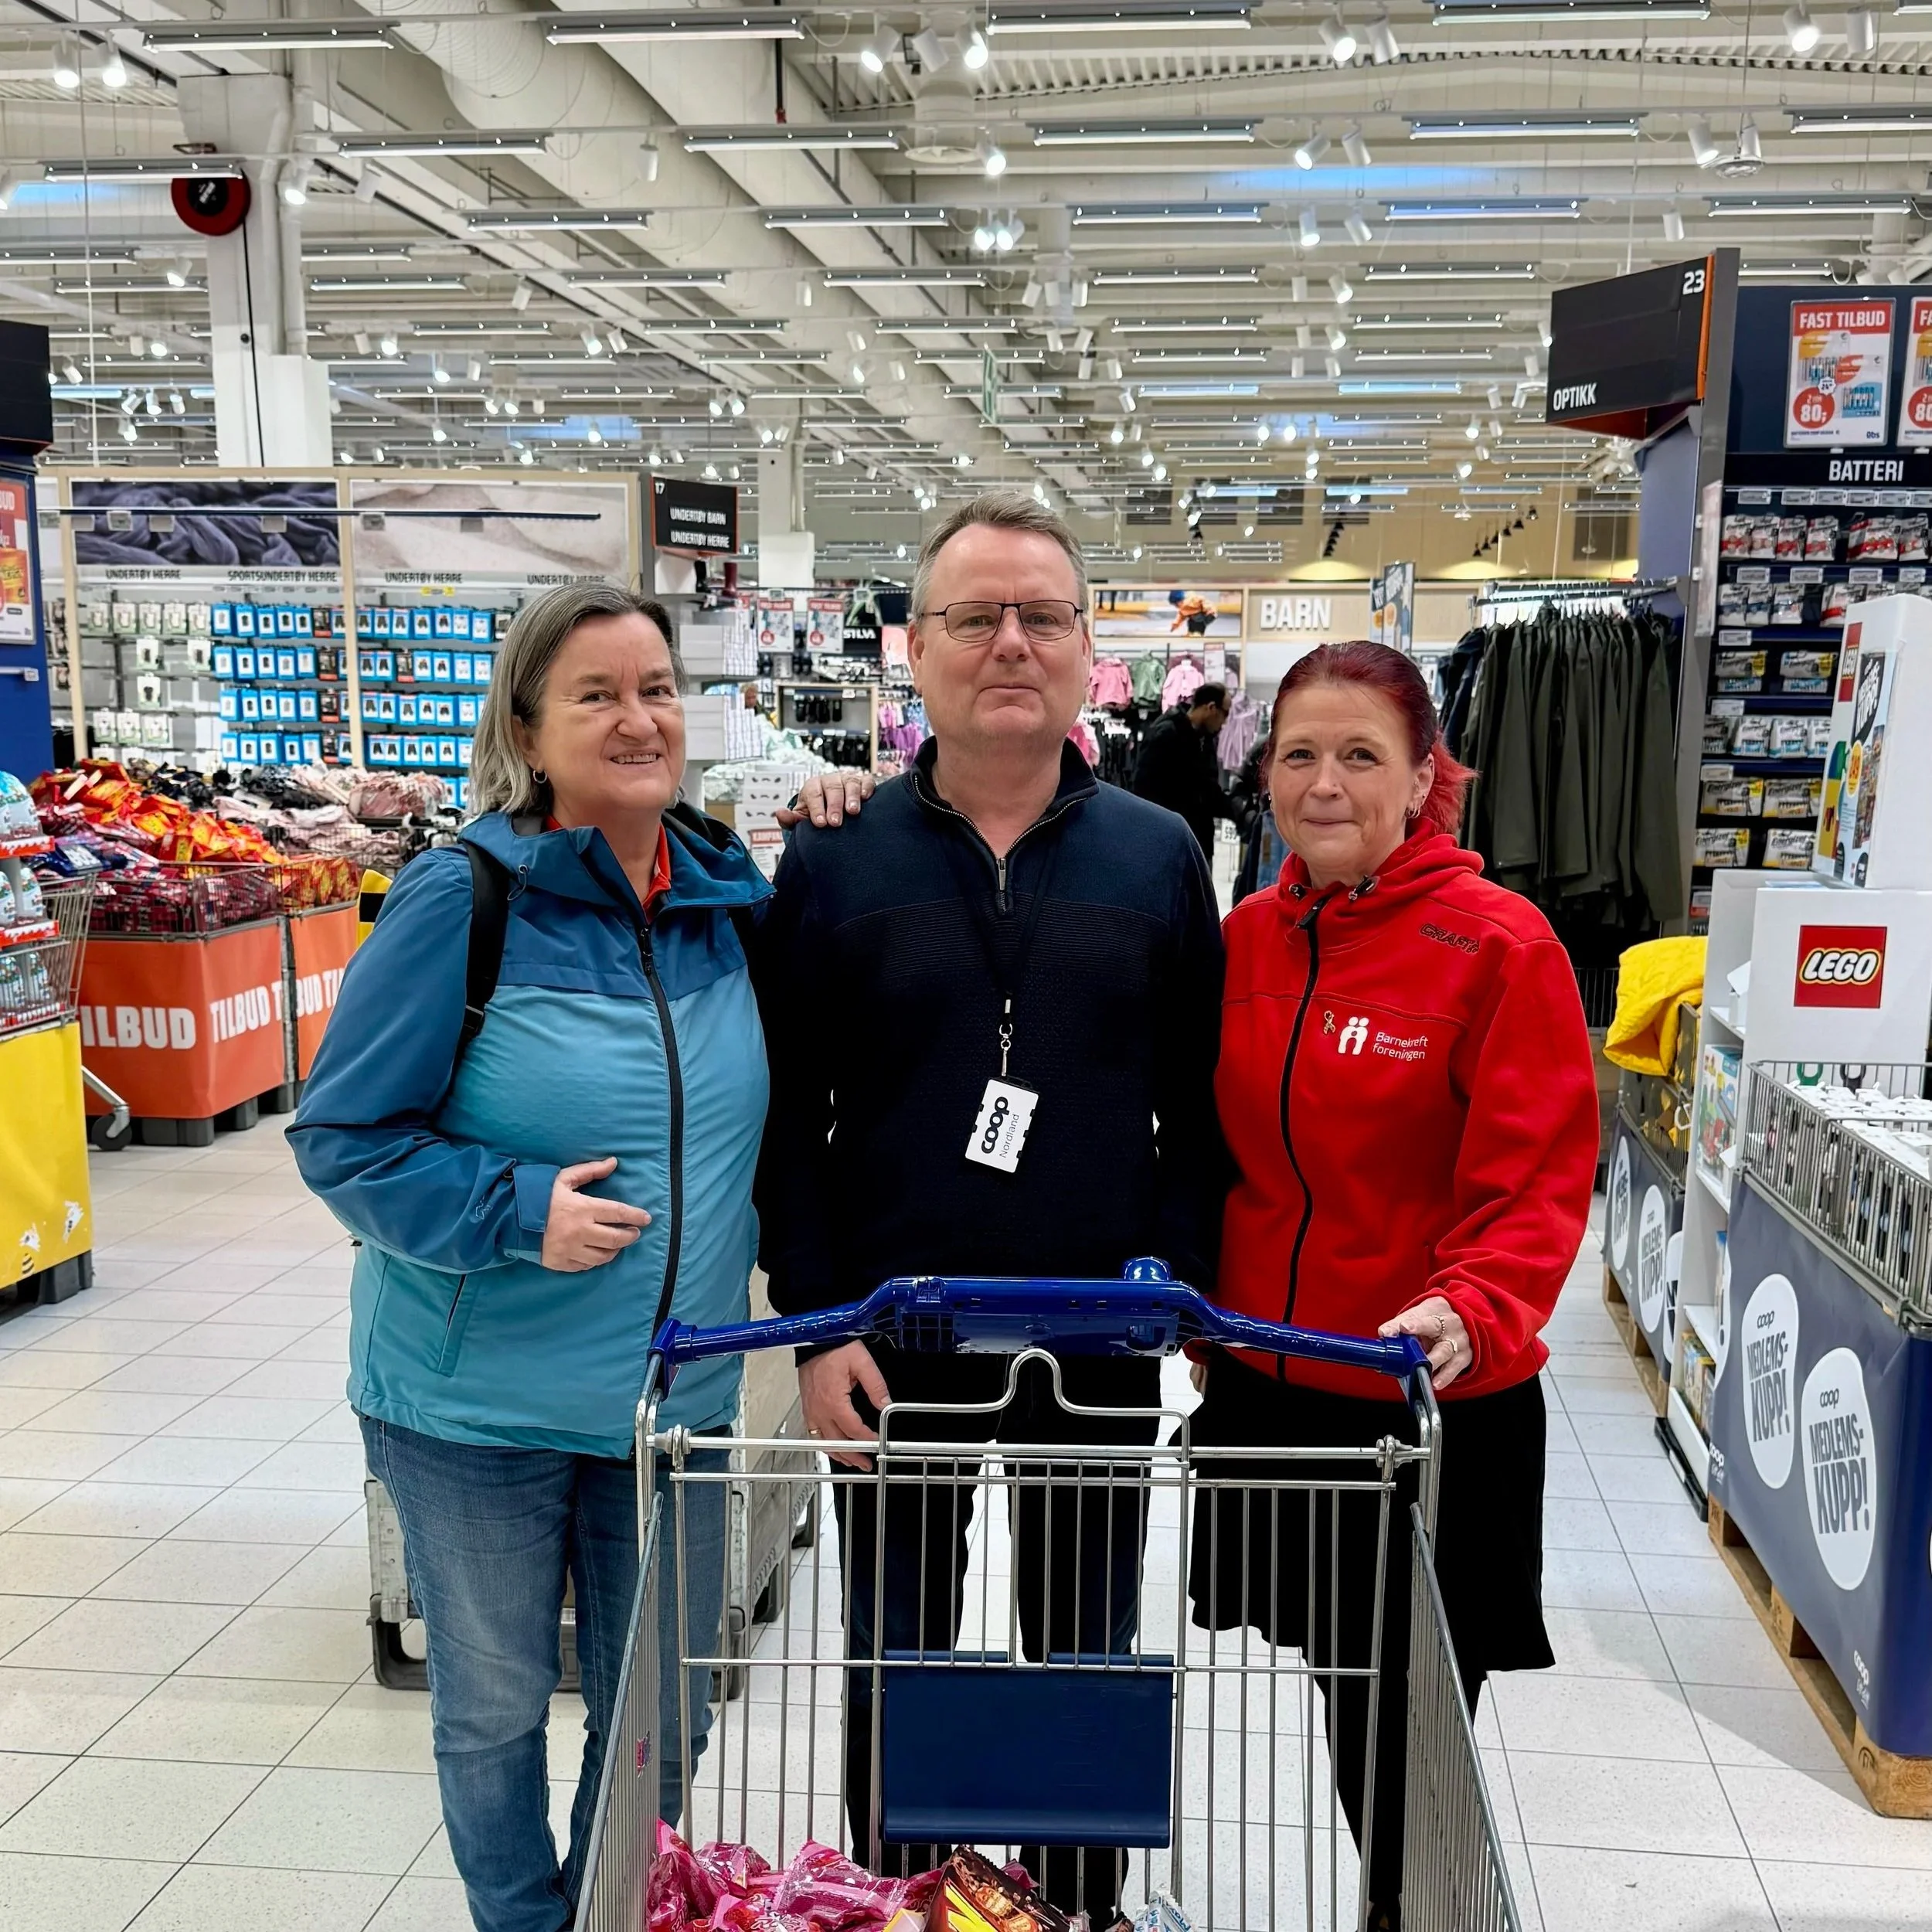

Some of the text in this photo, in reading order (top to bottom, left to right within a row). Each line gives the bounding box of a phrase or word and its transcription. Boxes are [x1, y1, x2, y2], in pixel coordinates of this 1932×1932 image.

[1682, 270, 1706, 295] 23
[1799, 311, 1886, 328] FAST TILBUD
[1553, 383, 1597, 410] OPTIKK
[1828, 460, 1904, 481] BATTERI
[655, 481, 665, 495] 17
[669, 506, 726, 526] UNDERTØY BARN
[670, 530, 730, 549] UNDERTØY HERRE
[105, 569, 182, 580] UNDERTØY HERRE
[227, 570, 338, 583] SPORTSUNDERTØY HERRE
[384, 572, 463, 584] UNDERTØY HERRE
[526, 574, 575, 586] UNDERTØY
[1260, 597, 1332, 629] BARN
[842, 628, 877, 640] SILVA
[1801, 950, 1879, 982] LEGO
[209, 985, 271, 1043] TILBUD
[80, 1006, 196, 1049] ILBUD
[1375, 1031, 1429, 1048] Barnekreft
[1372, 1043, 1426, 1062] foreningen
[981, 1096, 1010, 1155] coop
[998, 1113, 1020, 1159] Nordland
[1641, 1248, 1663, 1304] KUPP!
[1757, 1310, 1775, 1330] coop
[1747, 1330, 1788, 1382] MEDLEMS-
[1750, 1368, 1791, 1443] KUPP!
[1819, 1388, 1839, 1409] coop
[1809, 1413, 1864, 1464] MEDLEMS-
[1813, 1457, 1870, 1535] KUPP!
[1854, 1649, 1869, 1687] coop
